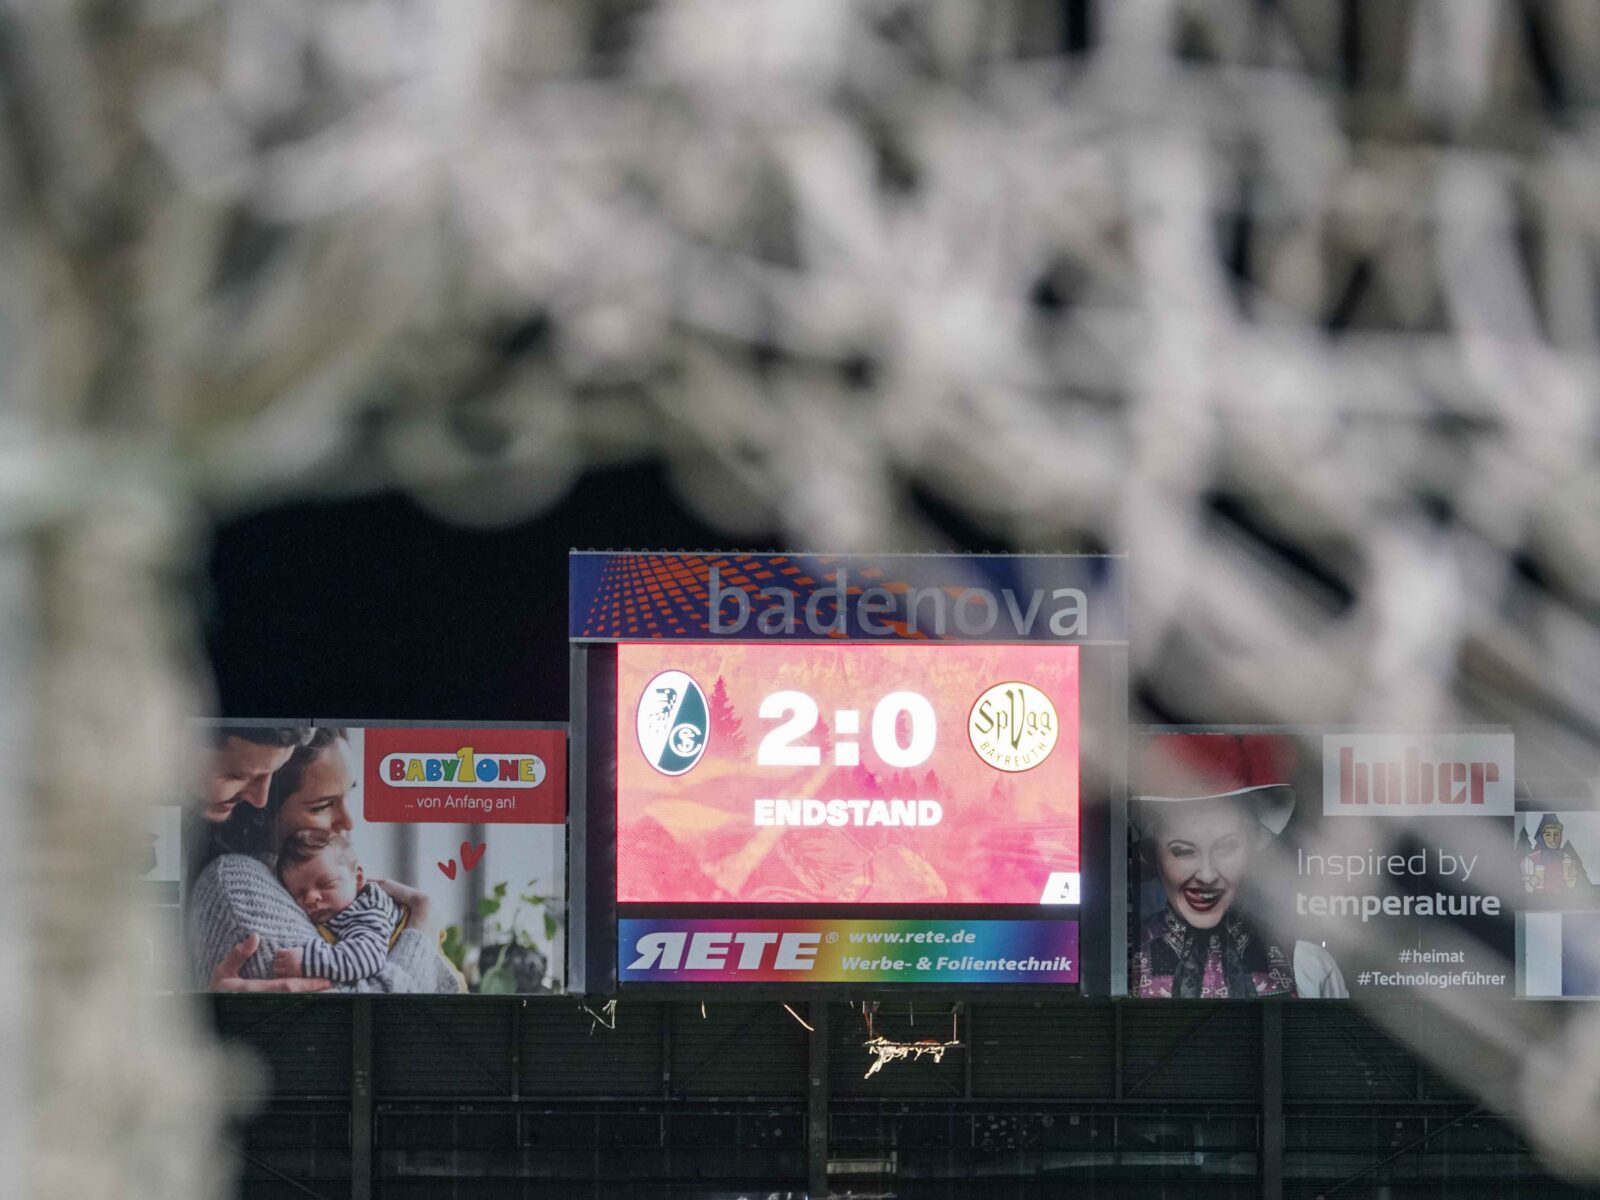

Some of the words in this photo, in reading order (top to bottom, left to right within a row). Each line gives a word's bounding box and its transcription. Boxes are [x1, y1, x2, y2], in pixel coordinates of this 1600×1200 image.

[708, 567, 1088, 637] badenova
[757, 690, 937, 768] 2:0
[975, 688, 1051, 751] SpVgg
[979, 741, 1048, 767] BAYREUTH
[1339, 747, 1499, 804] huber
[416, 798, 443, 809] von
[444, 795, 493, 812] Anfang
[495, 796, 516, 809] an!
[754, 799, 943, 827] ENDSTAND
[1298, 848, 1427, 882] Inspired
[1438, 848, 1478, 882] by
[1296, 892, 1501, 922] temperature
[849, 929, 976, 944] www.rete.de
[841, 956, 912, 971] Werbe-
[916, 956, 931, 971] &
[936, 956, 1072, 971] Folientechnik
[1398, 950, 1465, 963] #heimat
[1357, 971, 1506, 988] #Technologieführer
